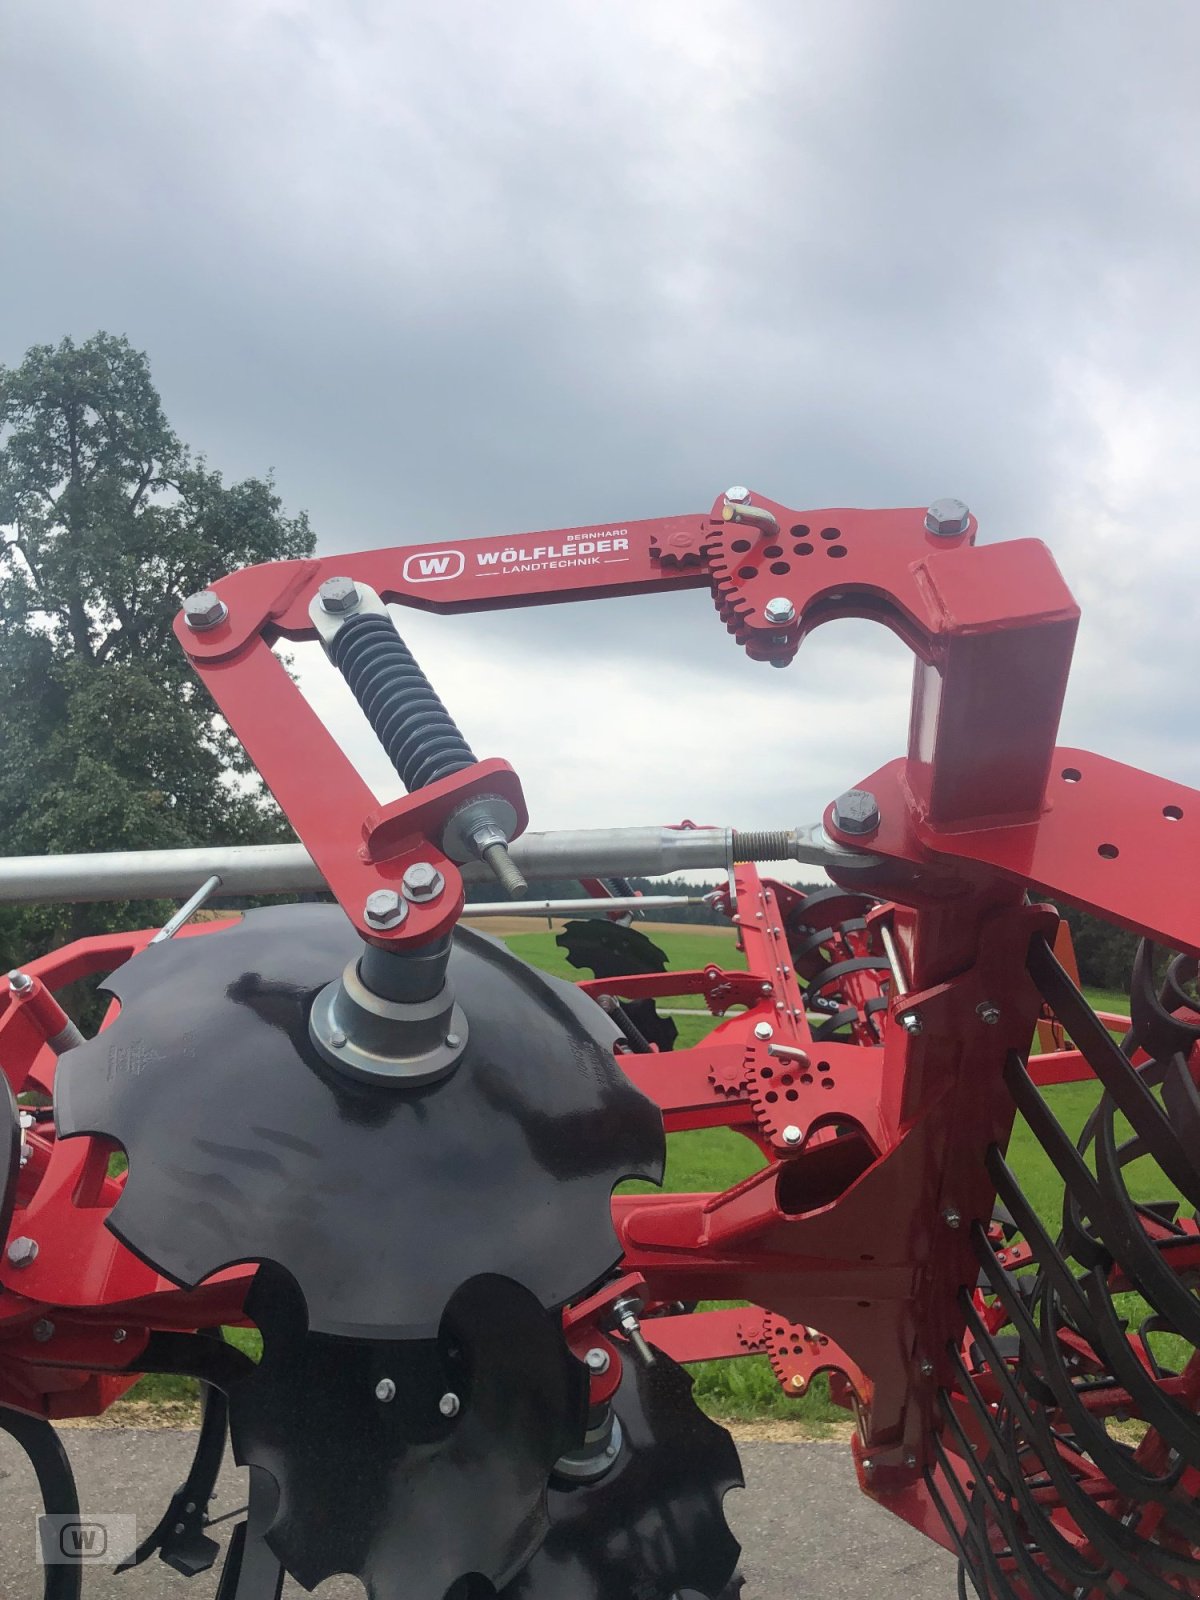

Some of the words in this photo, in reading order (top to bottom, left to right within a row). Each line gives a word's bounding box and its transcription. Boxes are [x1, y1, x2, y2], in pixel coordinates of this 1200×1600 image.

[566, 529, 628, 542] BERNHARD
[476, 538, 629, 566] WÖLFLEDER
[419, 557, 450, 575] W
[502, 557, 601, 574] LANDTECHNIK
